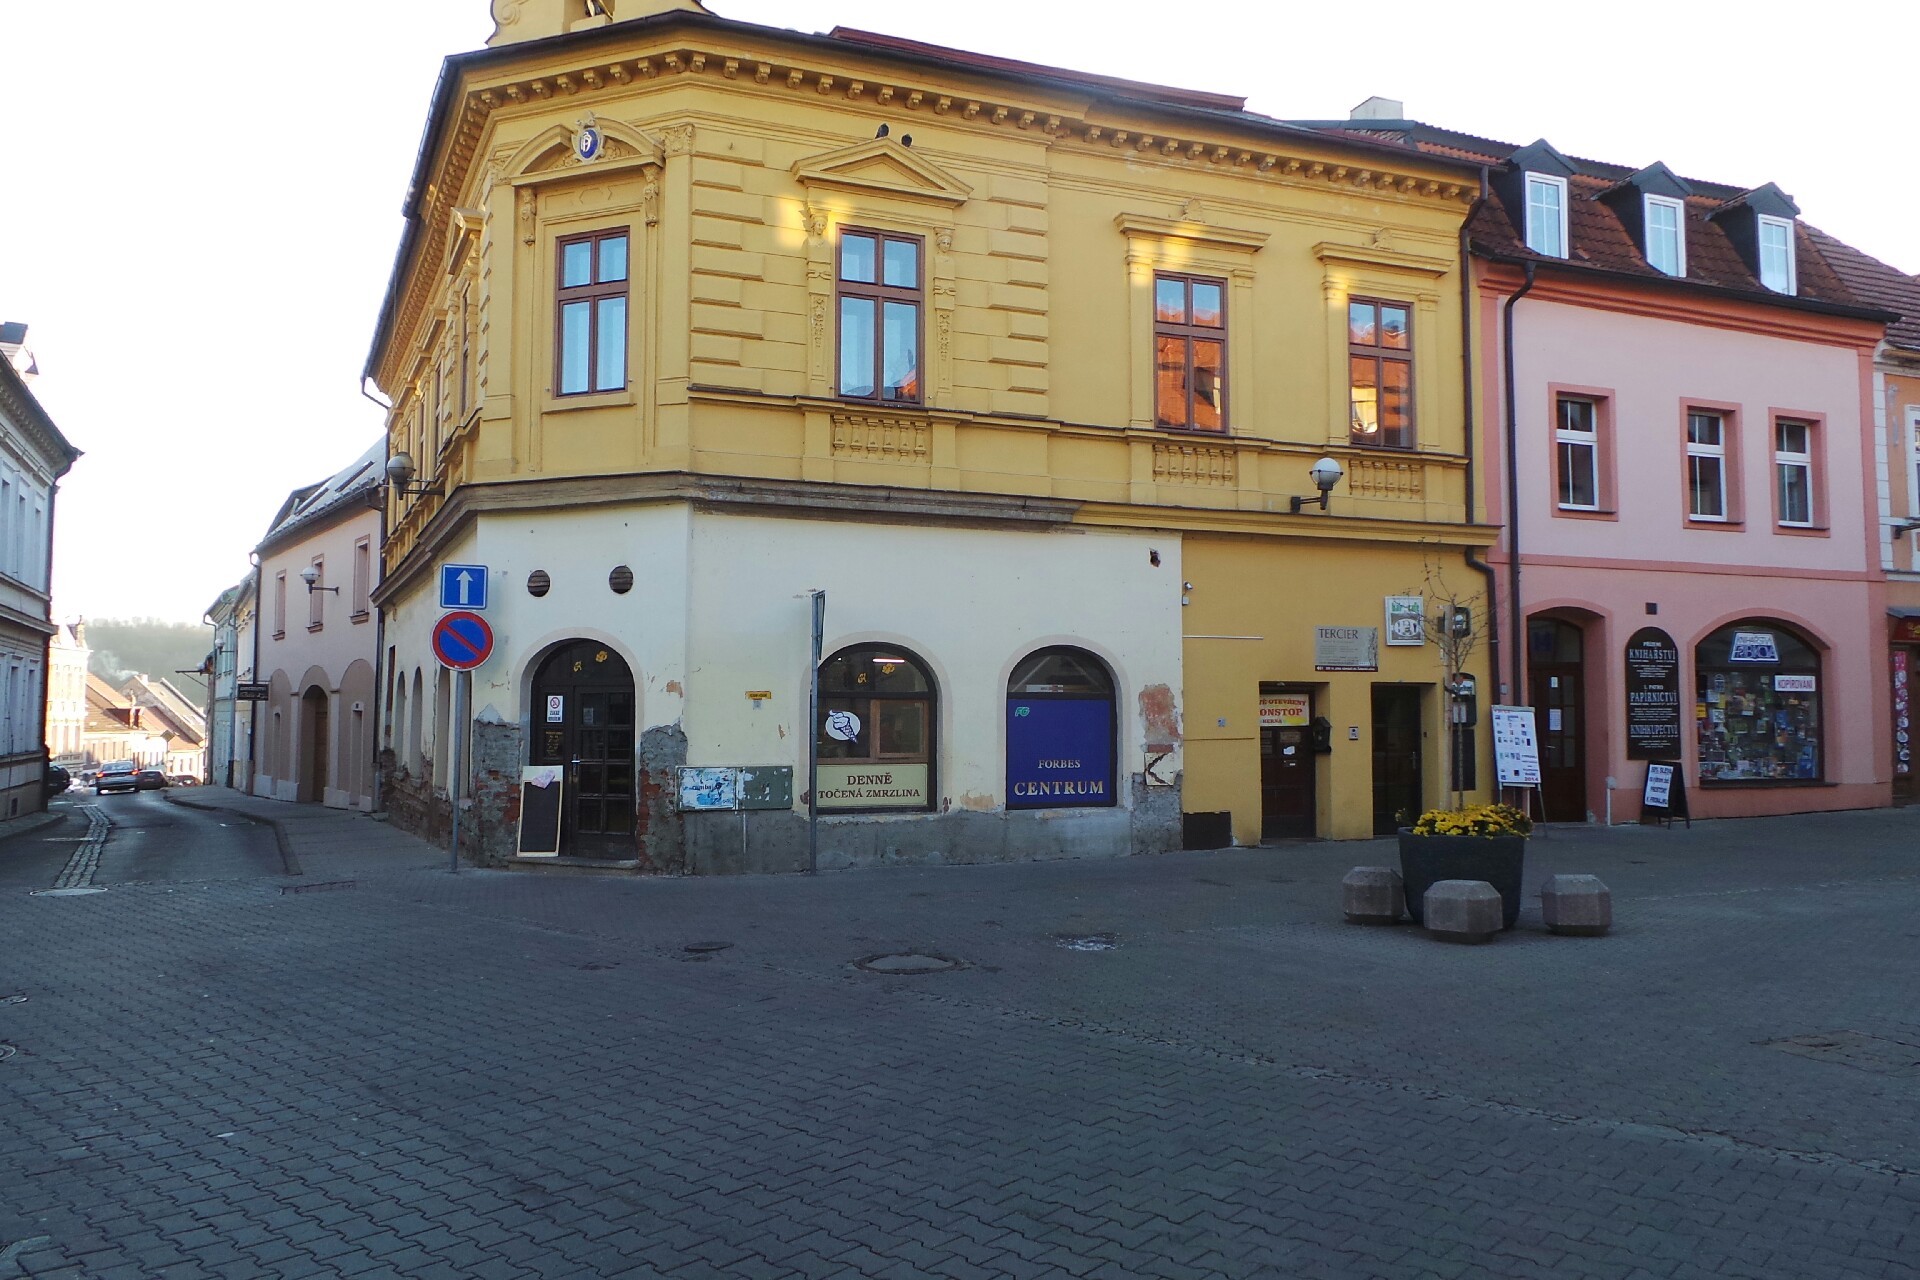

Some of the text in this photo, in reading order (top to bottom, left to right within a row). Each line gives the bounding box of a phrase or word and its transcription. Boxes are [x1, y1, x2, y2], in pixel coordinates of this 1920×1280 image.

[1318, 628, 1359, 640] TERCIER
[1629, 647, 1676, 660] KNIHAŘSTVÍ
[1630, 690, 1678, 703] PAPÍRNICTVÍ
[1259, 708, 1303, 717] ONSTOP
[1038, 759, 1081, 769] FORBES
[847, 772, 893, 786] DENNĚ
[818, 788, 921, 799] TOČENÁ ZMRZLINA
[1014, 781, 1104, 796] CENTRUM
